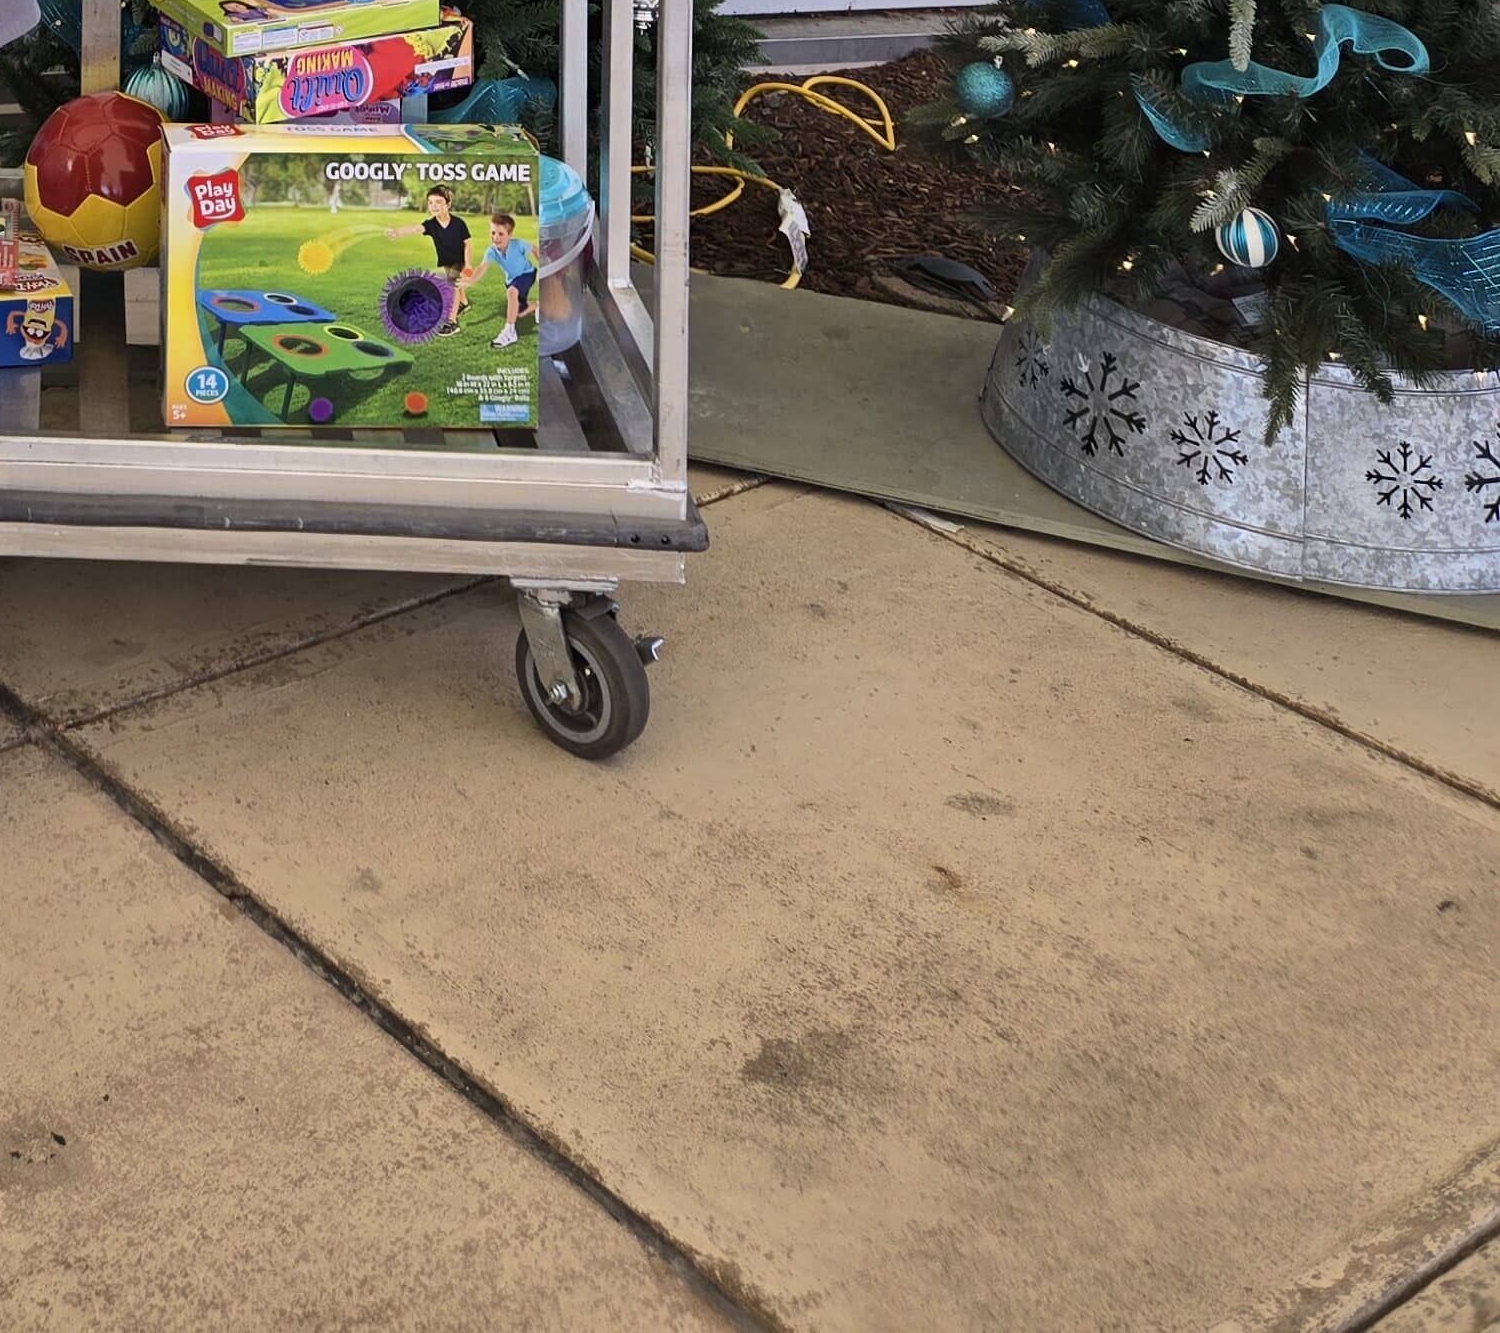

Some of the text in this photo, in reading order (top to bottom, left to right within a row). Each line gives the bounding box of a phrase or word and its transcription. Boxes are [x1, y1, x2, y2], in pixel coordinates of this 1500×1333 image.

[297, 49, 354, 74] MAKING
[287, 67, 364, 111] Quilt
[416, 163, 467, 181] TOSS
[471, 164, 530, 182] GAME
[195, 179, 234, 200] Play
[199, 196, 236, 217] Day
[63, 240, 139, 265] SPAIN
[196, 373, 218, 389] 14
[195, 389, 219, 397] PIECES
[172, 409, 187, 421] 5+
